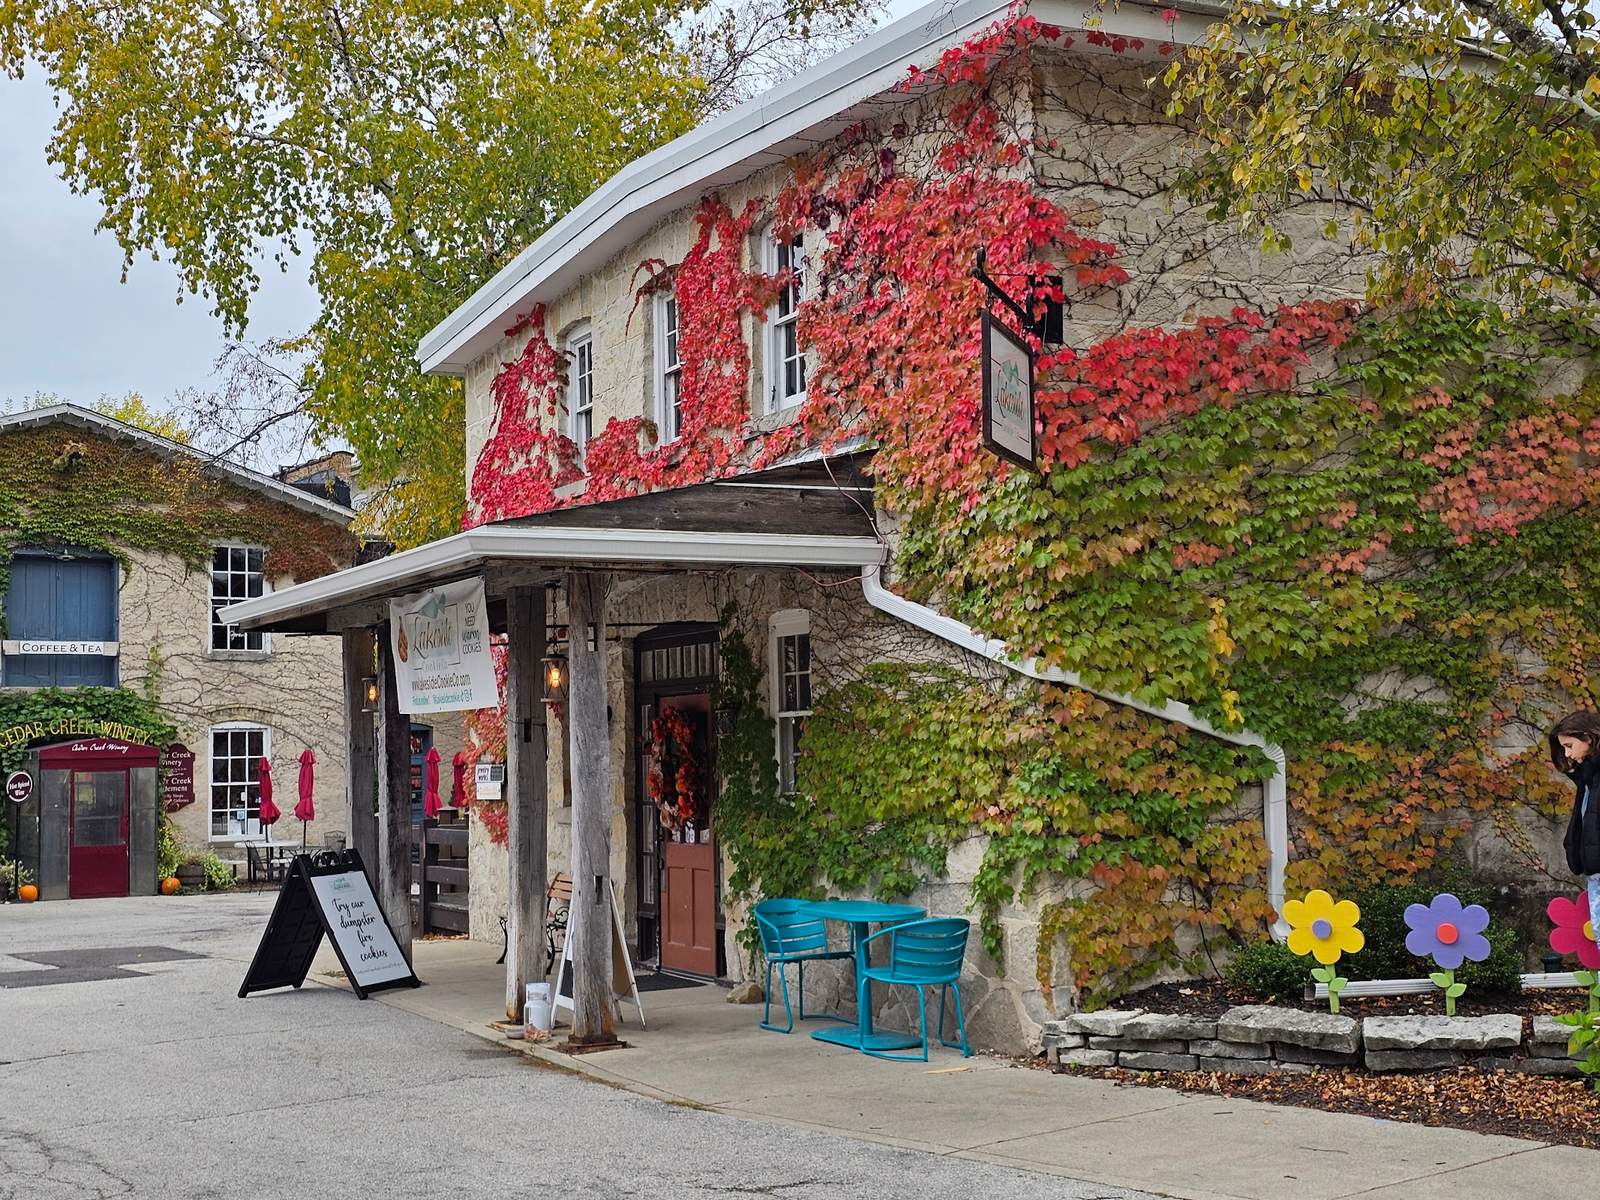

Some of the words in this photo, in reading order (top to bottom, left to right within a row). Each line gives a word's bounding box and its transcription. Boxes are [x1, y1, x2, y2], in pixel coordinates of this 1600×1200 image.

[464, 602, 475, 614] YOU
[22, 643, 67, 653] COFFEE
[69, 643, 78, 653] &
[80, 643, 102, 653] TEA
[0, 721, 44, 747] CEDAR
[171, 777, 192, 785] Creek
[340, 911, 376, 933] dumpster
[357, 930, 374, 947] fire
[360, 946, 388, 962] cookies
